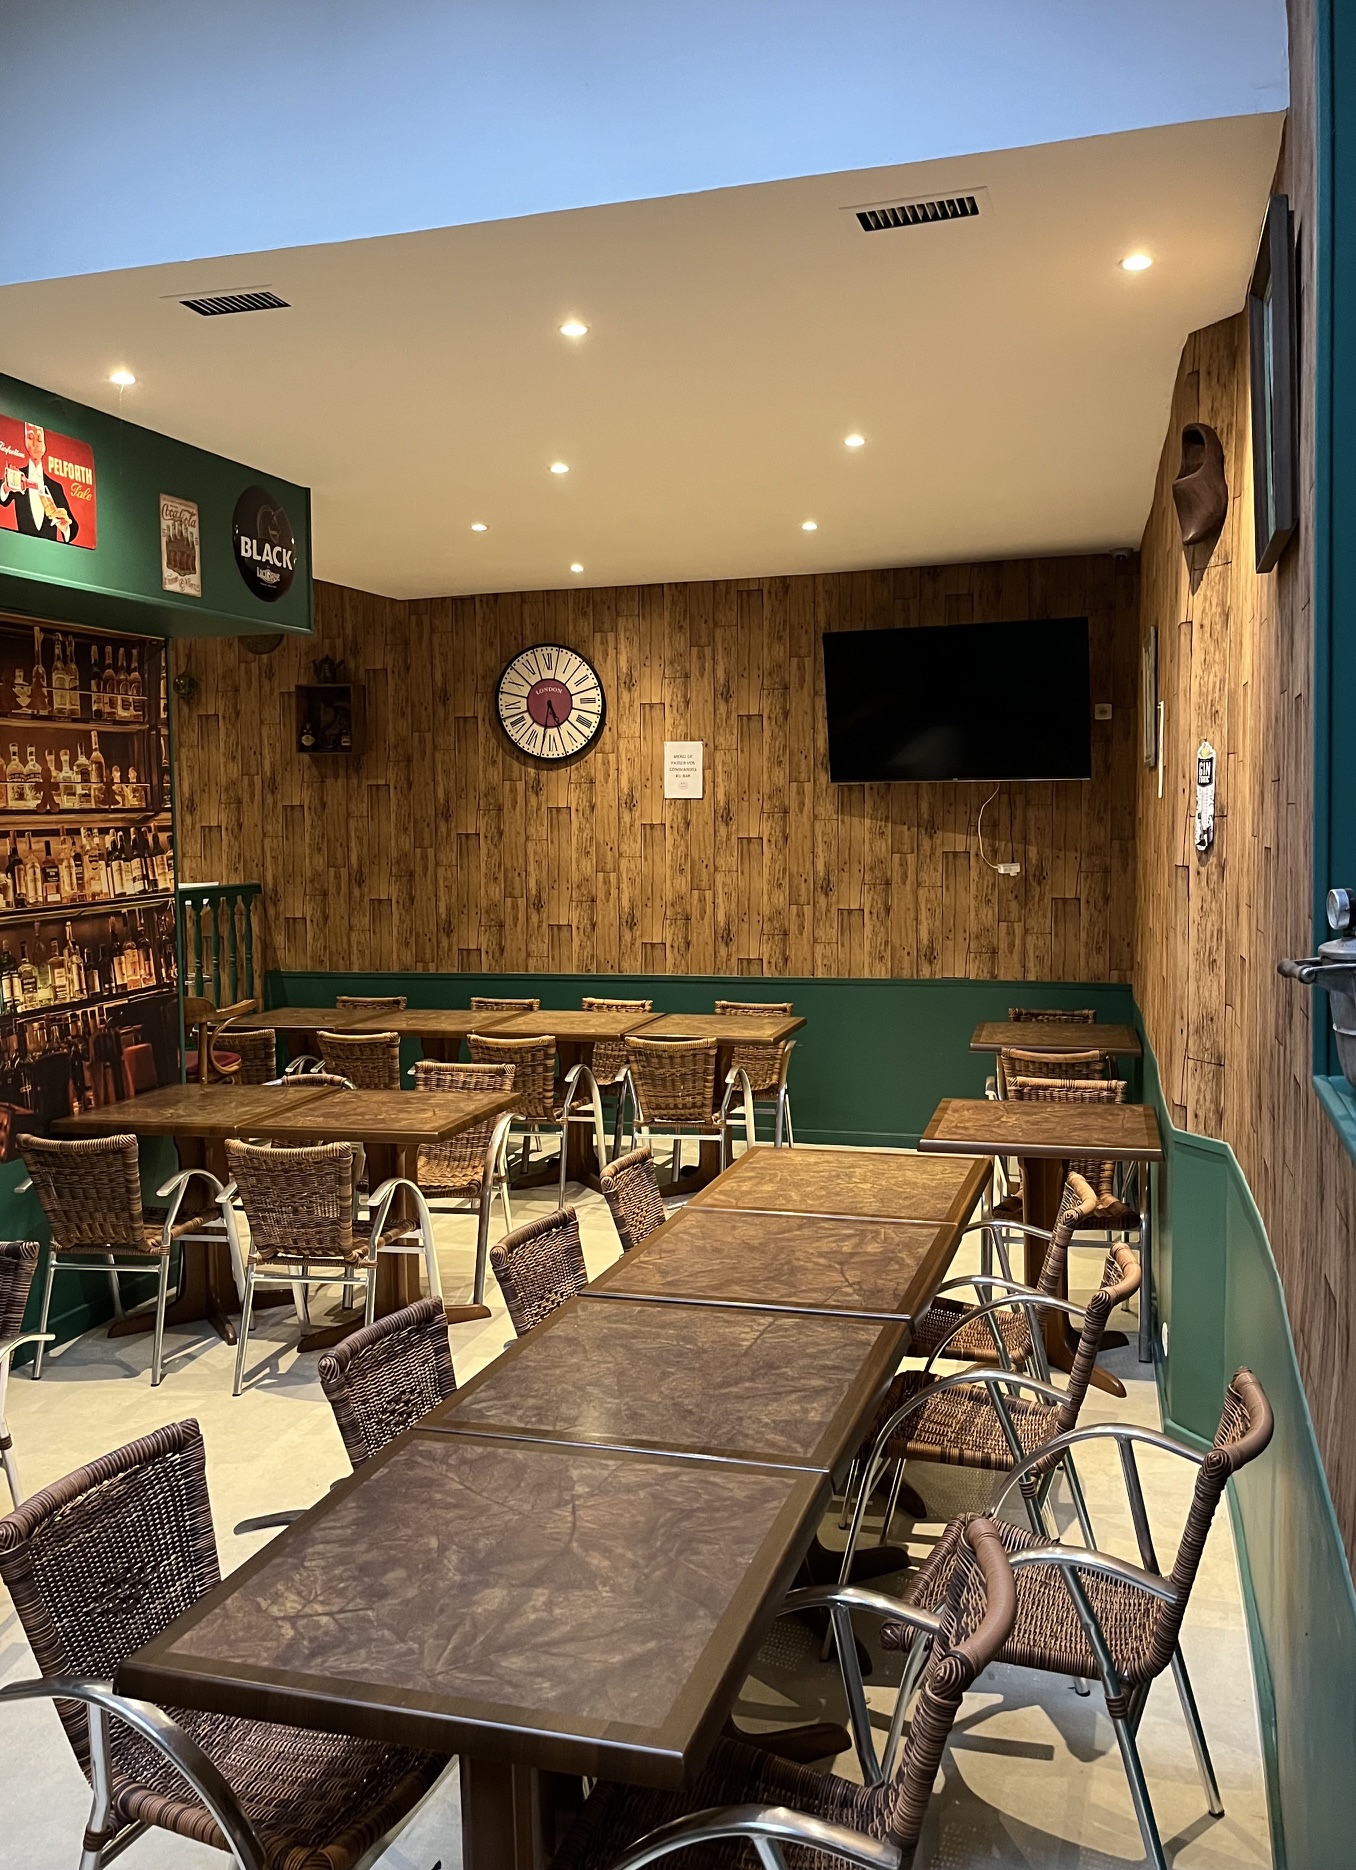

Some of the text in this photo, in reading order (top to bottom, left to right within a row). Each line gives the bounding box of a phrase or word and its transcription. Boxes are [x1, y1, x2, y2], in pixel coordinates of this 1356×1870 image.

[48, 455, 93, 486] PELFORTH
[240, 535, 293, 571] BLACK
[535, 686, 563, 695] LONDON
[1199, 761, 1211, 776] GIN
